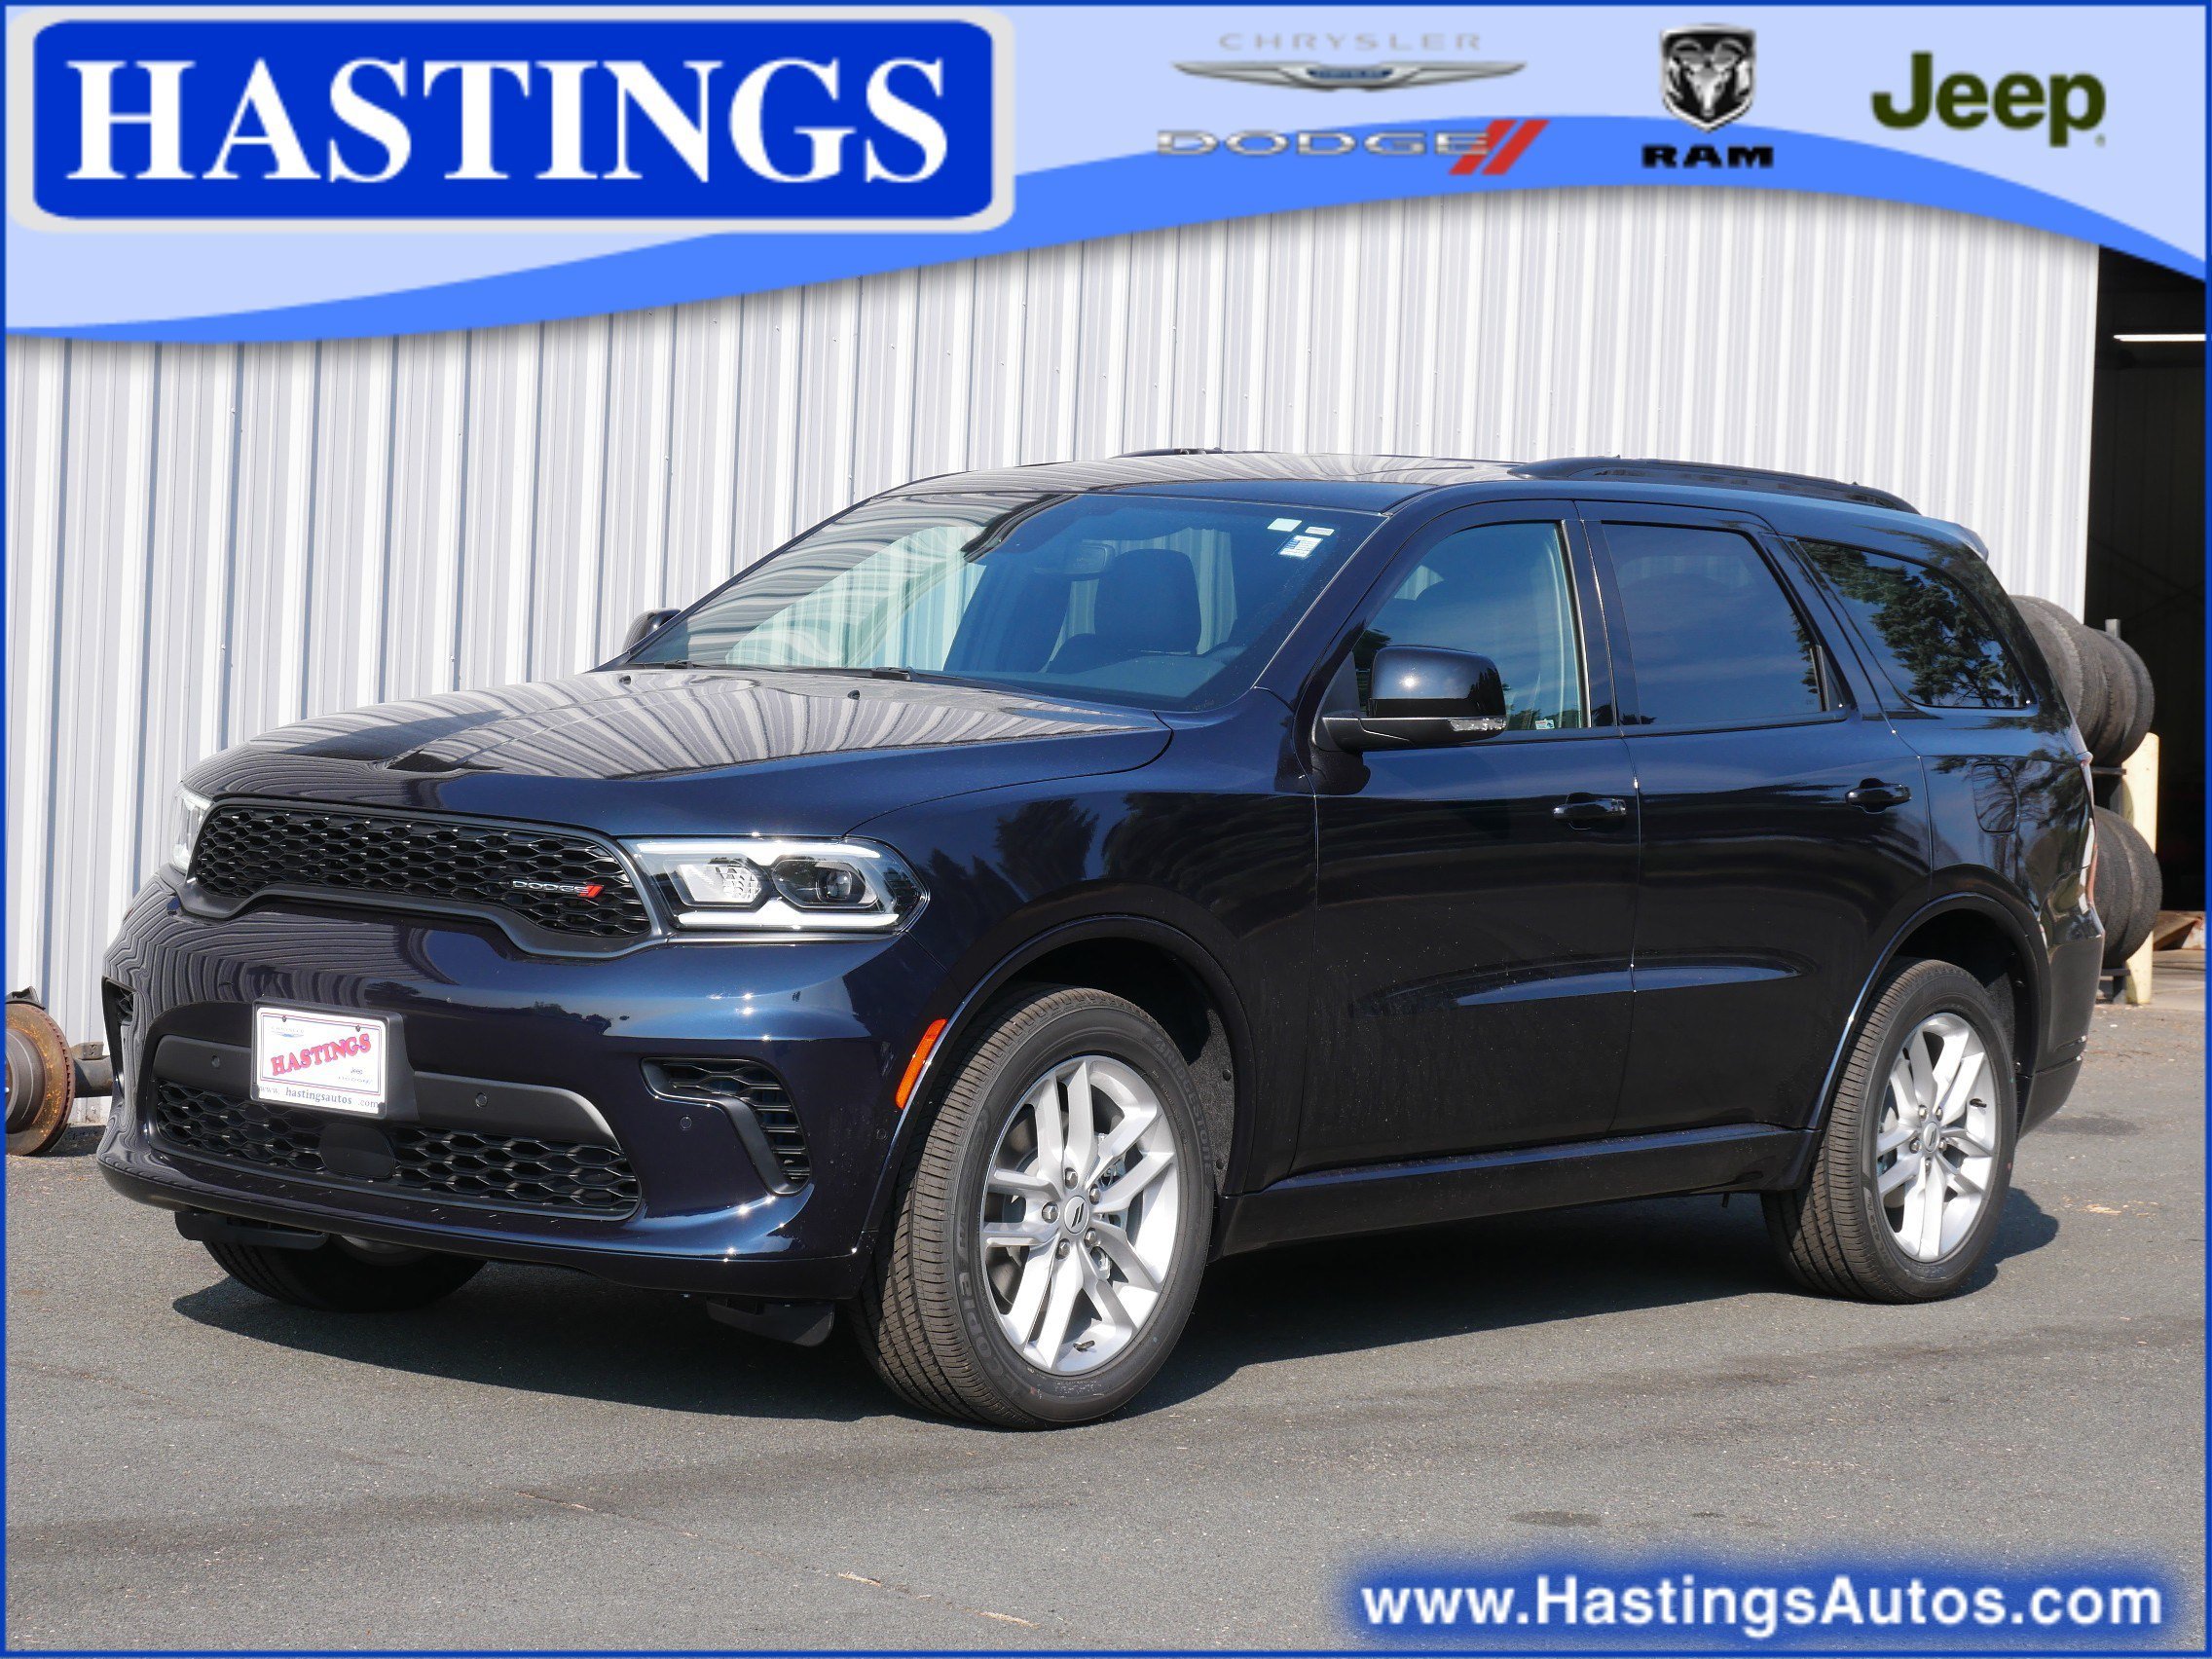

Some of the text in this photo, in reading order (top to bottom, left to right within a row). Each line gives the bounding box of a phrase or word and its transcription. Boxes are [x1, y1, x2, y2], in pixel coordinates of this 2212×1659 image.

[512, 880, 589, 895] DODGE
[271, 1033, 372, 1077] HASTINGS
[285, 1087, 352, 1105] hastingsautos
